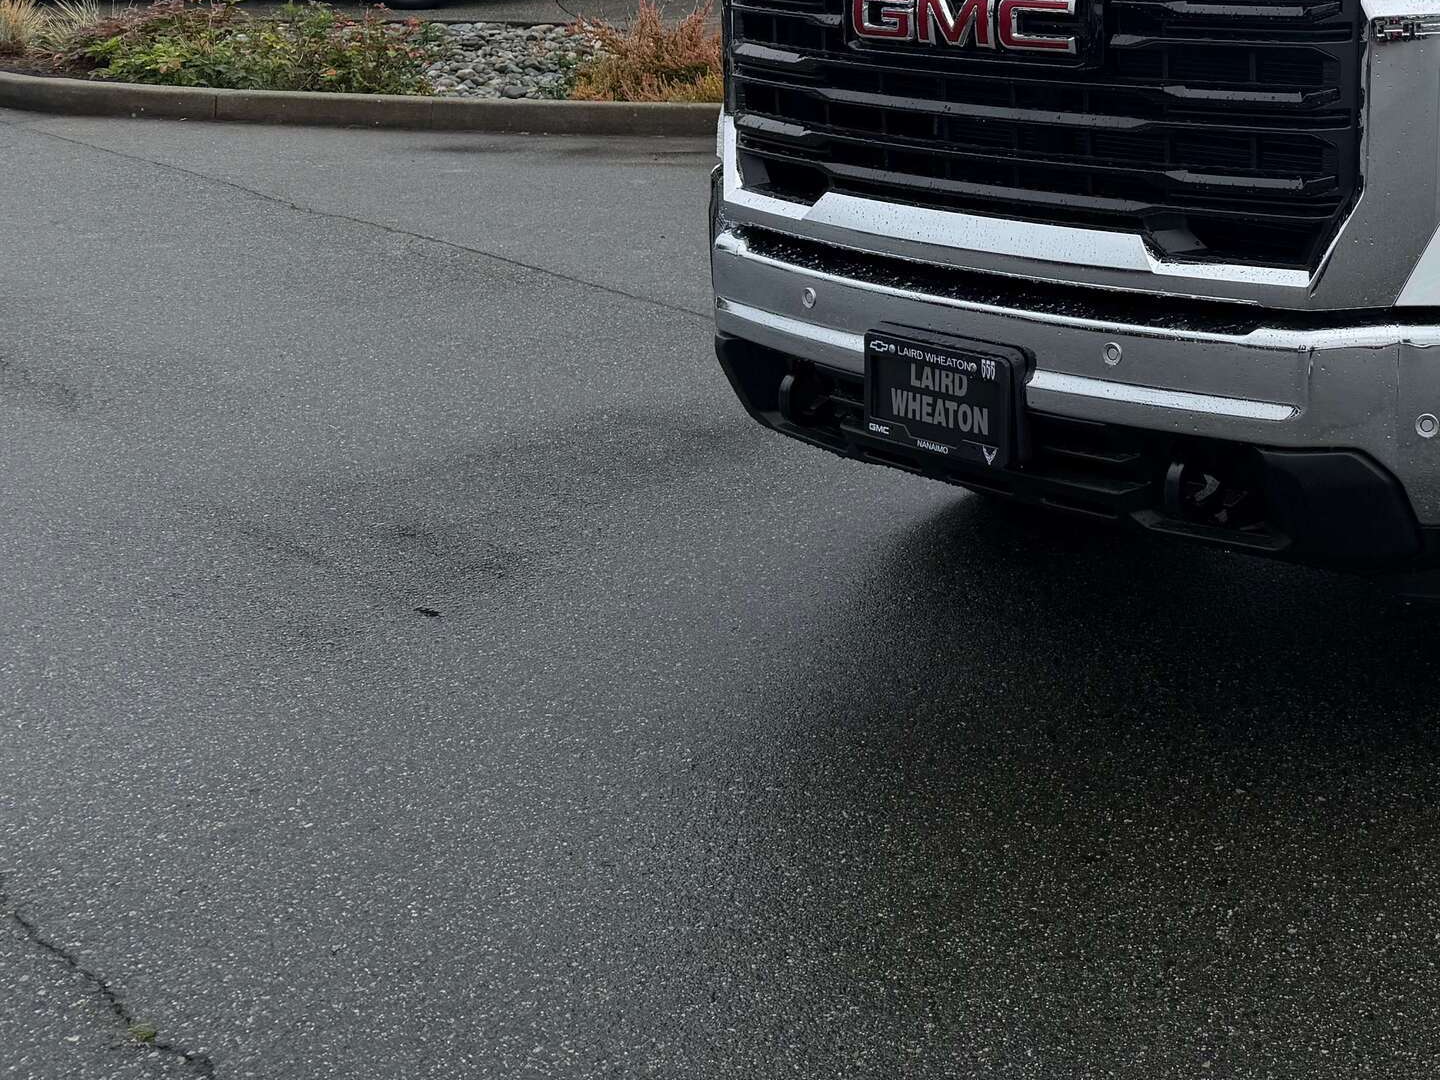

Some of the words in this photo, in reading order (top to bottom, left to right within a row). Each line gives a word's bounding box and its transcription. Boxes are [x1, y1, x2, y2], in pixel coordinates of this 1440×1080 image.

[897, 345, 923, 360] LAIRD
[924, 352, 972, 372] WHEATON
[910, 363, 968, 397] LAIRD
[890, 387, 989, 436] WHEATON
[869, 422, 890, 435] GMC
[916, 439, 949, 455] NANAIMO
